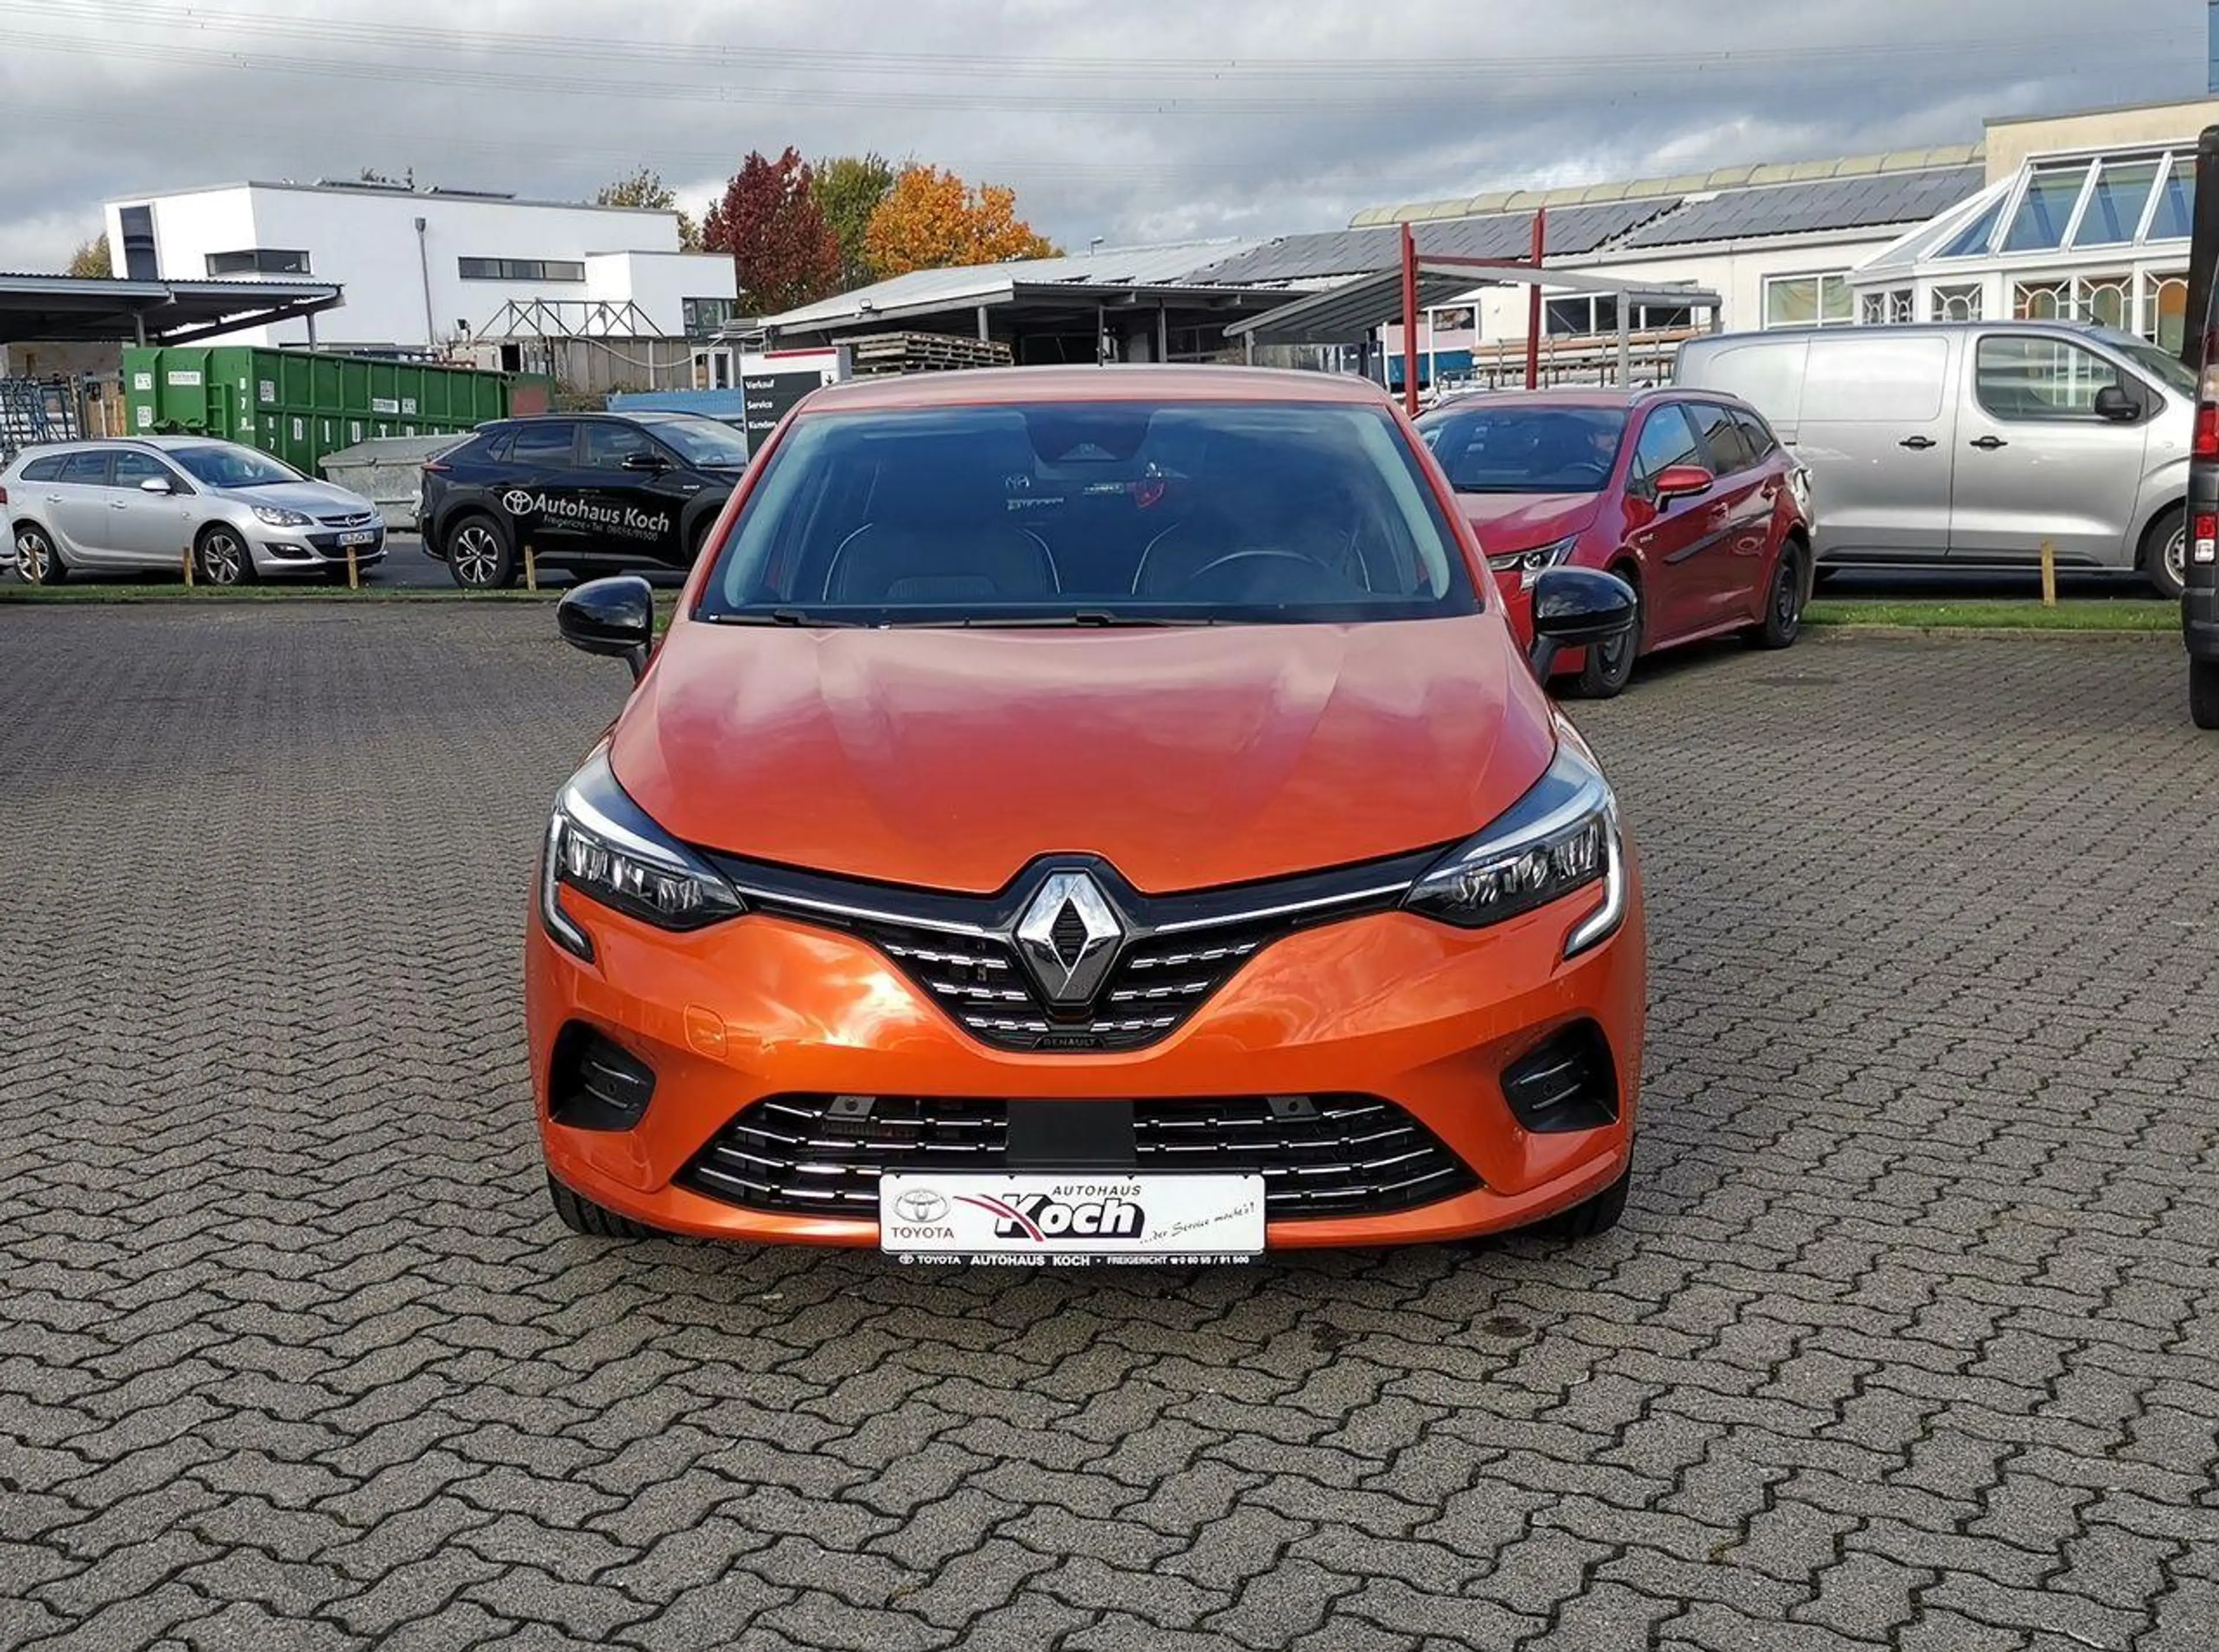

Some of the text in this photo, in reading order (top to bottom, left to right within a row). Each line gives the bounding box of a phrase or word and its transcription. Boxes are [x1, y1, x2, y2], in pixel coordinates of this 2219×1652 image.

[745, 379, 774, 389] Verkauf
[747, 400, 773, 410] Service
[533, 493, 669, 532] Autohaus Koch
[1044, 1038, 1095, 1046] RENAULT
[1052, 1185, 1142, 1196] AUTOHAUS
[995, 1193, 1145, 1238] Koch
[890, 1227, 954, 1239] TOYOTA
[1171, 1219, 1209, 1237] Service
[918, 1255, 962, 1264] TOYOTA
[970, 1255, 1045, 1266] AUTOHAUS
[1053, 1255, 1090, 1266] KOCH
[1107, 1256, 1167, 1264] FREIGERICHT
